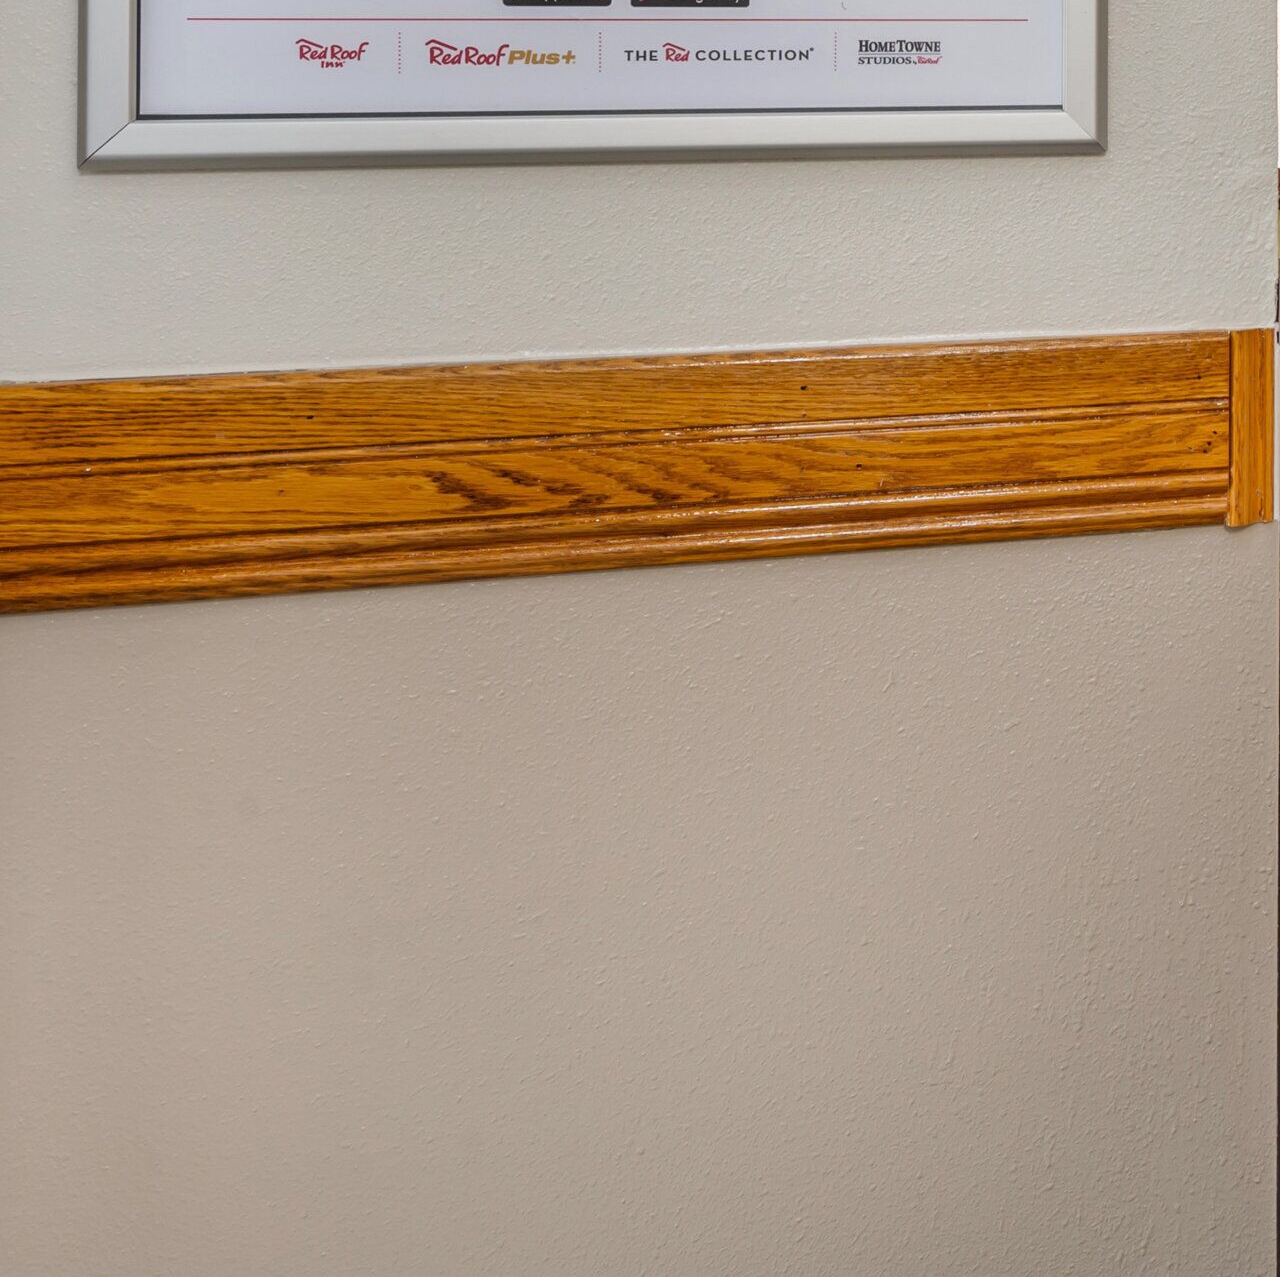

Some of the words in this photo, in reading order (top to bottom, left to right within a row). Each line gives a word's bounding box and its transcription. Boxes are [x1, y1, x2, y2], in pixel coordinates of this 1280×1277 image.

[623, 49, 658, 61] THE
[665, 47, 690, 62] Red
[694, 49, 809, 61] COLLECTION
[857, 56, 910, 65] STUDIOS
